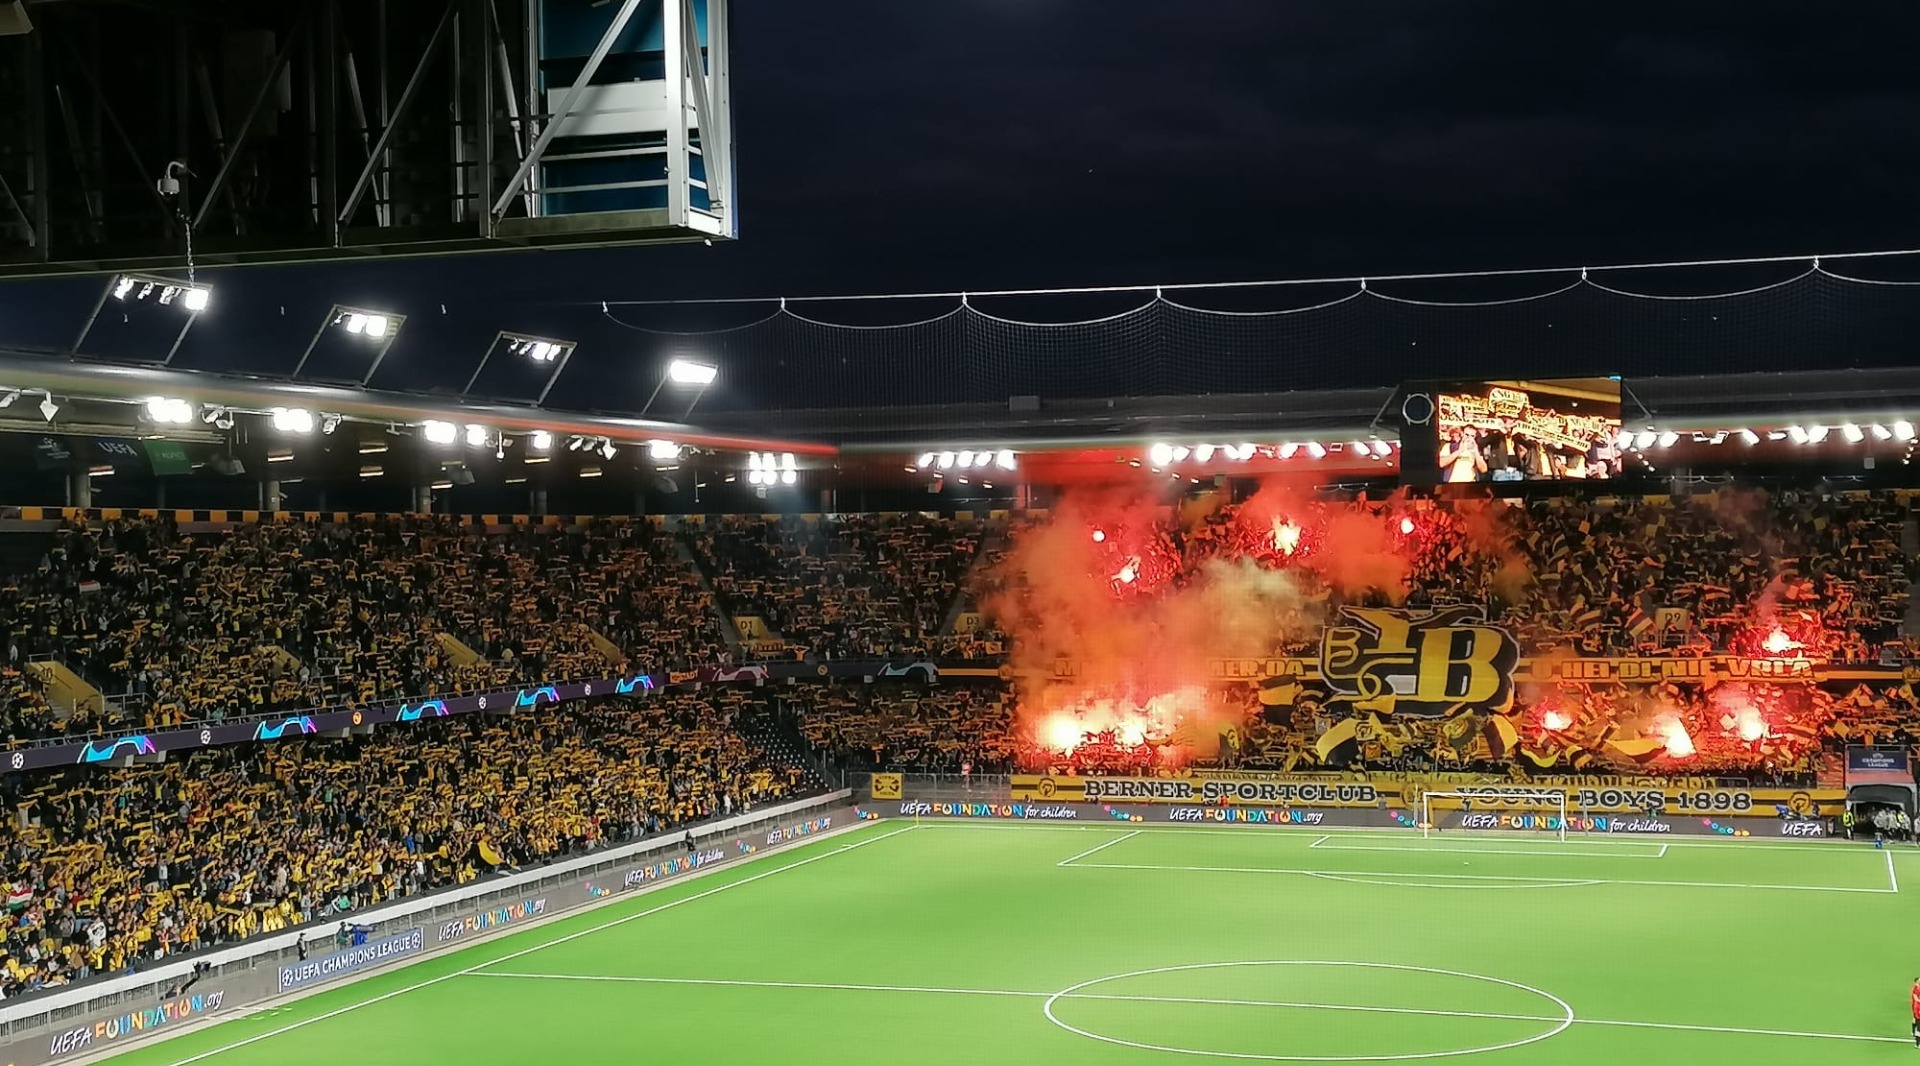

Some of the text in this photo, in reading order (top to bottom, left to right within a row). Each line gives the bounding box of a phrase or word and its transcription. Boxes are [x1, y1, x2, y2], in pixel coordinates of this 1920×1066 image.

[98, 442, 138, 456] UEFA
[1561, 660, 1610, 679] HEI
[1084, 779, 1752, 810] BERNER SPORTCLUB YOUNG BOYS 1898
[900, 802, 1077, 819] UEFA FOUNDATION for children
[1170, 807, 1203, 821] UEFA
[1462, 814, 1671, 833] UEFA FOUNDATION for children
[1782, 822, 1823, 836] UEFA
[438, 920, 464, 941] UEFA
[295, 936, 412, 981] UEFA CHAMPIONS LEAGUE
[50, 1026, 93, 1056] UEFA
